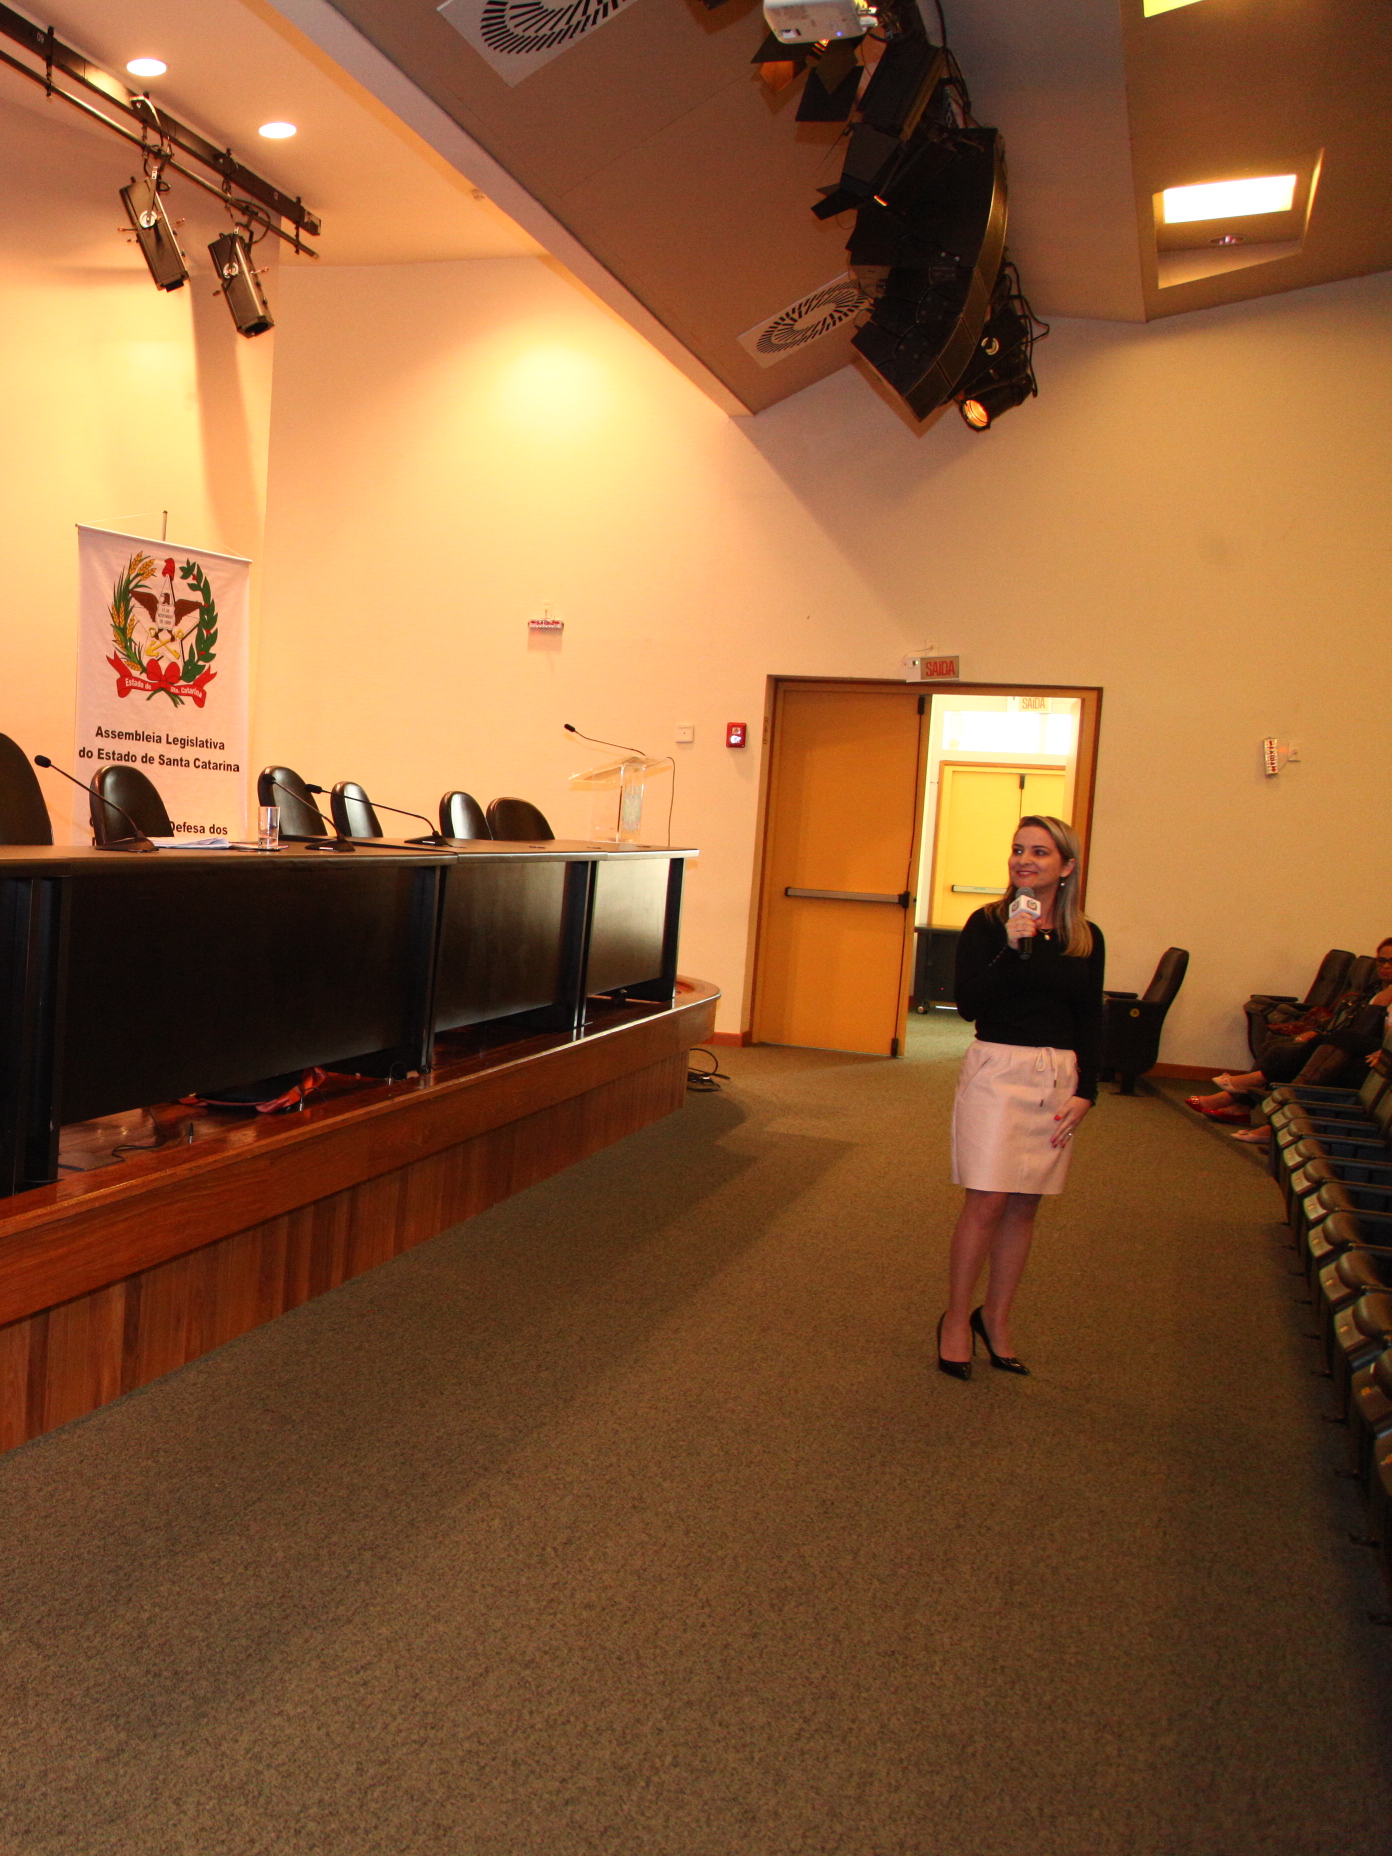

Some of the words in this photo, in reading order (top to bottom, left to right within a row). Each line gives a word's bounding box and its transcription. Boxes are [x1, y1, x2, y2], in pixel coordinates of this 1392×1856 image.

[95, 725, 162, 744] Assembleia
[166, 733, 225, 751] Legislativa
[78, 747, 94, 760] do
[97, 748, 138, 764] Estado
[141, 753, 155, 765] de
[158, 754, 191, 768] Santa
[193, 757, 240, 773] Catarina
[209, 823, 229, 836] dos
